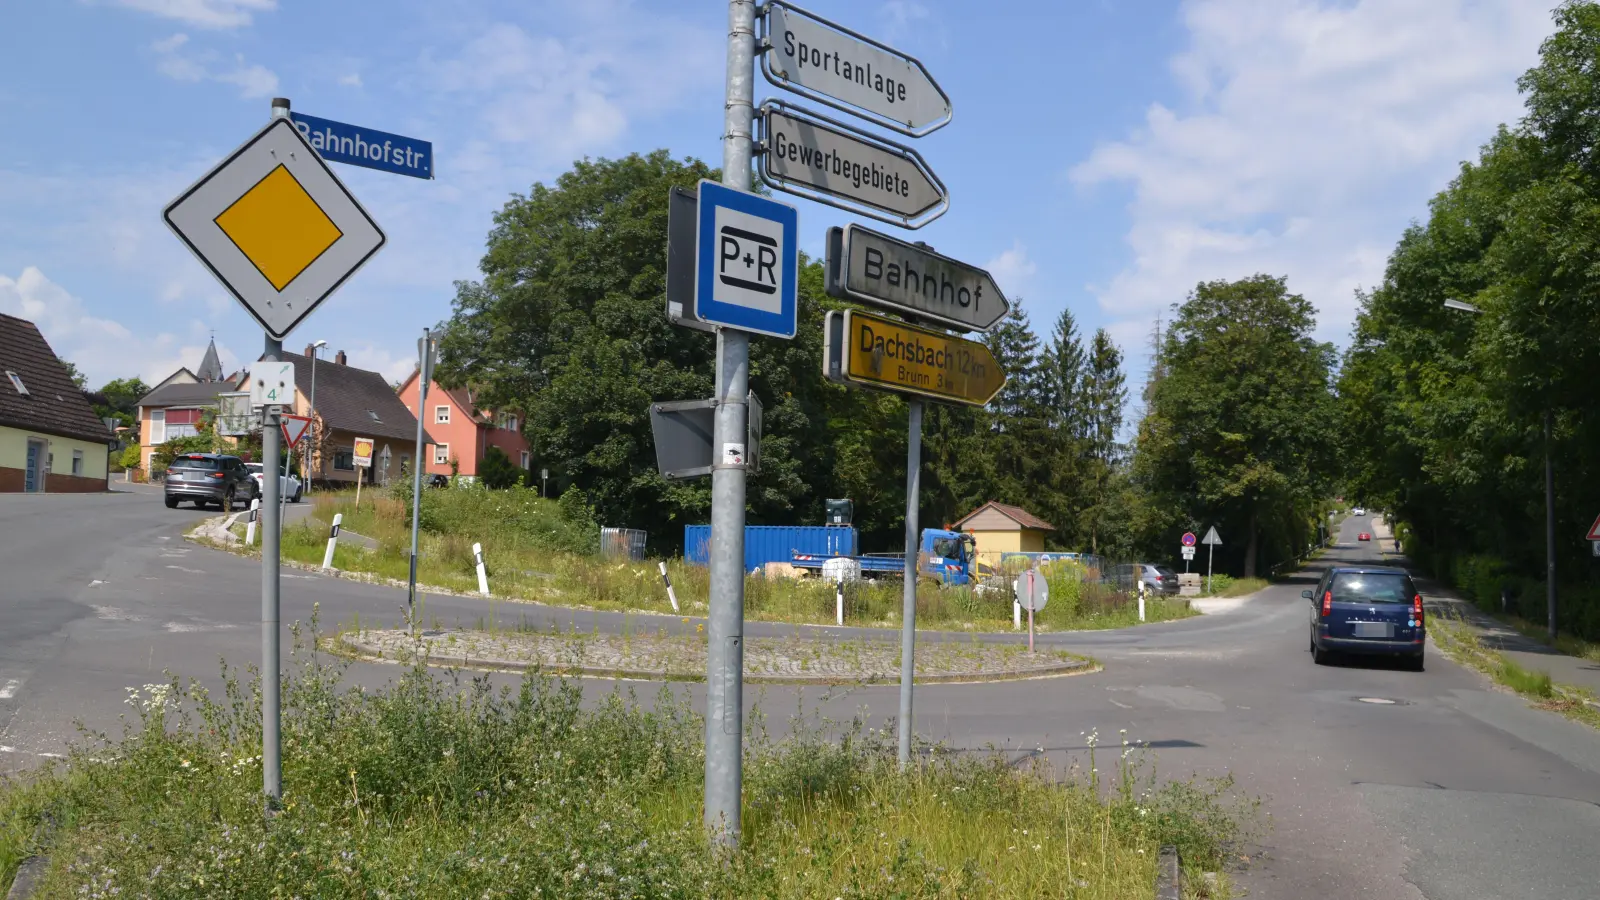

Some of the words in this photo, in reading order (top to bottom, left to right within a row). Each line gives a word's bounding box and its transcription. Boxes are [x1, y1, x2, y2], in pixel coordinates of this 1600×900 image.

[784, 30, 906, 103] Sportanlage
[775, 132, 909, 198] Gewerbegebiete
[720, 235, 777, 285] P+R
[864, 246, 982, 312] Bahnhof
[860, 324, 954, 371] Dachsbach
[956, 349, 970, 376] 12
[971, 355, 986, 379] km
[897, 365, 930, 385] Brunn
[936, 373, 943, 388] 3
[267, 388, 277, 401] 4
